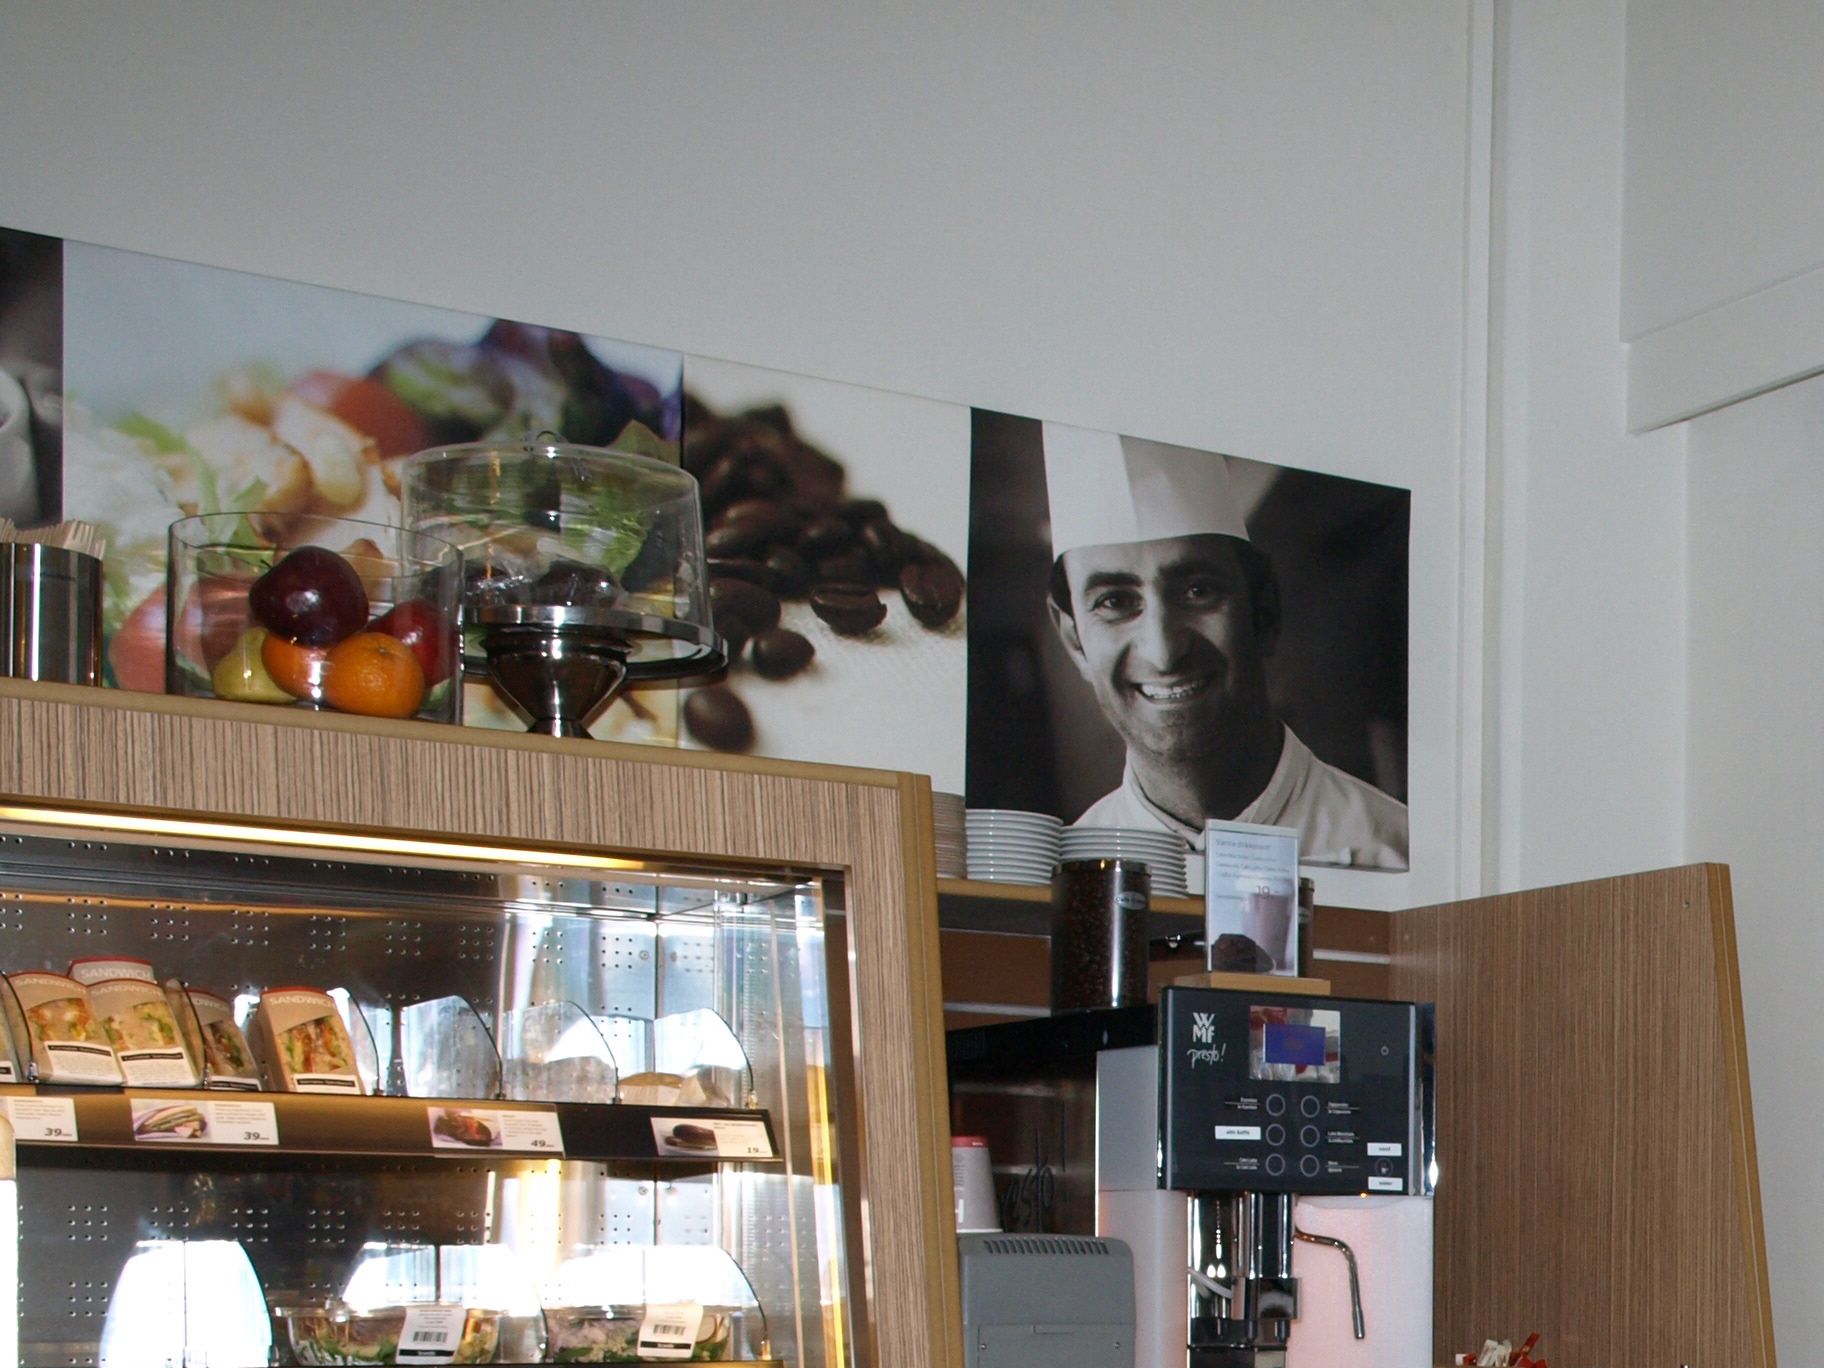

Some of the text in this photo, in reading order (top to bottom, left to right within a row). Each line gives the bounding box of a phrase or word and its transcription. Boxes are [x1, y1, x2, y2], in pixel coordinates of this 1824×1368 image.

[81, 967, 151, 978] SANDWICH
[44, 1127, 63, 1137] 39
[243, 1131, 260, 1141] 39
[530, 1139, 547, 1148] 49
[746, 1146, 759, 1154] 19
